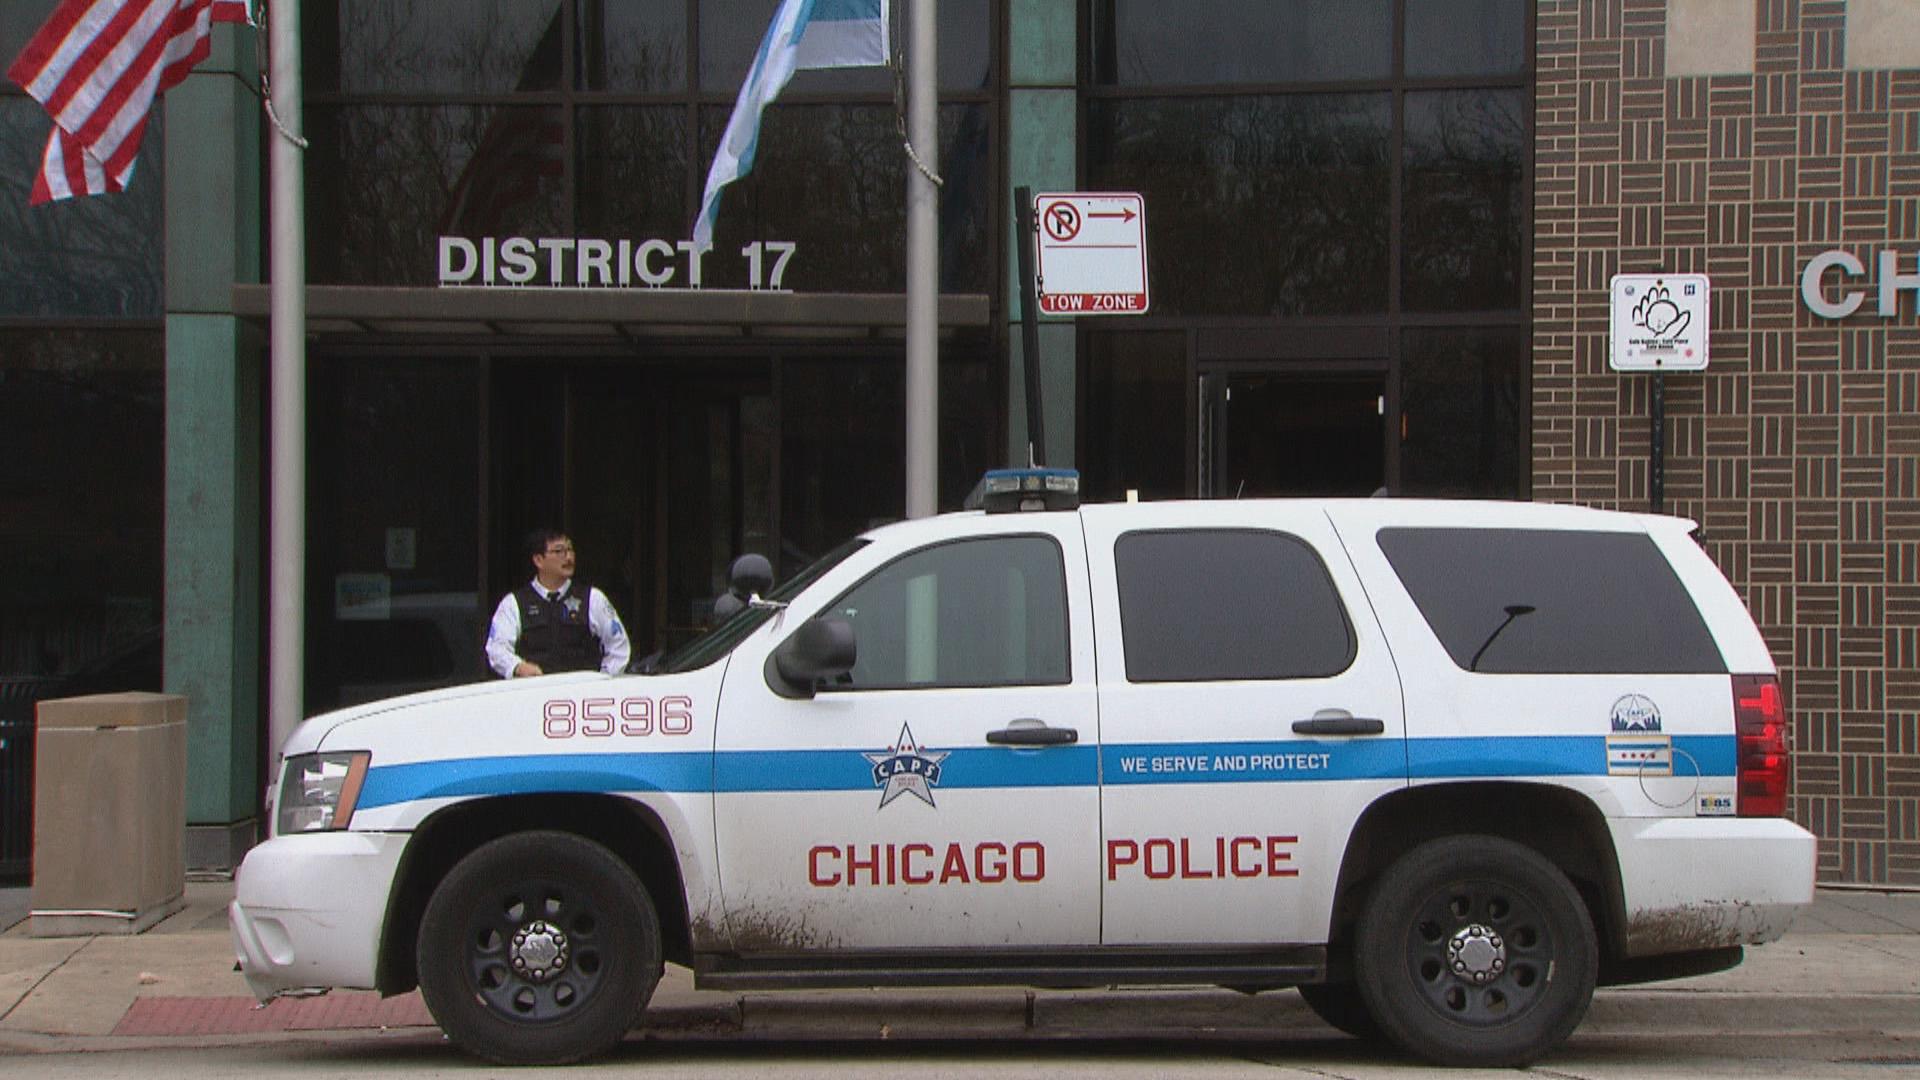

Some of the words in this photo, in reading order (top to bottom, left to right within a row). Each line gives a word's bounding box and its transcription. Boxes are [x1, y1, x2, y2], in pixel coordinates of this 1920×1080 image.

[438, 237, 713, 285] DISTRICT
[742, 241, 797, 286] 17
[1047, 295, 1083, 310] TOW
[1092, 295, 1138, 309] ZONE
[543, 695, 693, 739] 8596
[878, 759, 936, 777] CAPS
[1120, 757, 1148, 773] WE
[1151, 756, 1209, 772] SERVE
[1213, 755, 1247, 771] AND
[1251, 753, 1330, 770] PROTECT
[808, 841, 1046, 887] CHICAGO
[1106, 835, 1299, 881] POLICE
